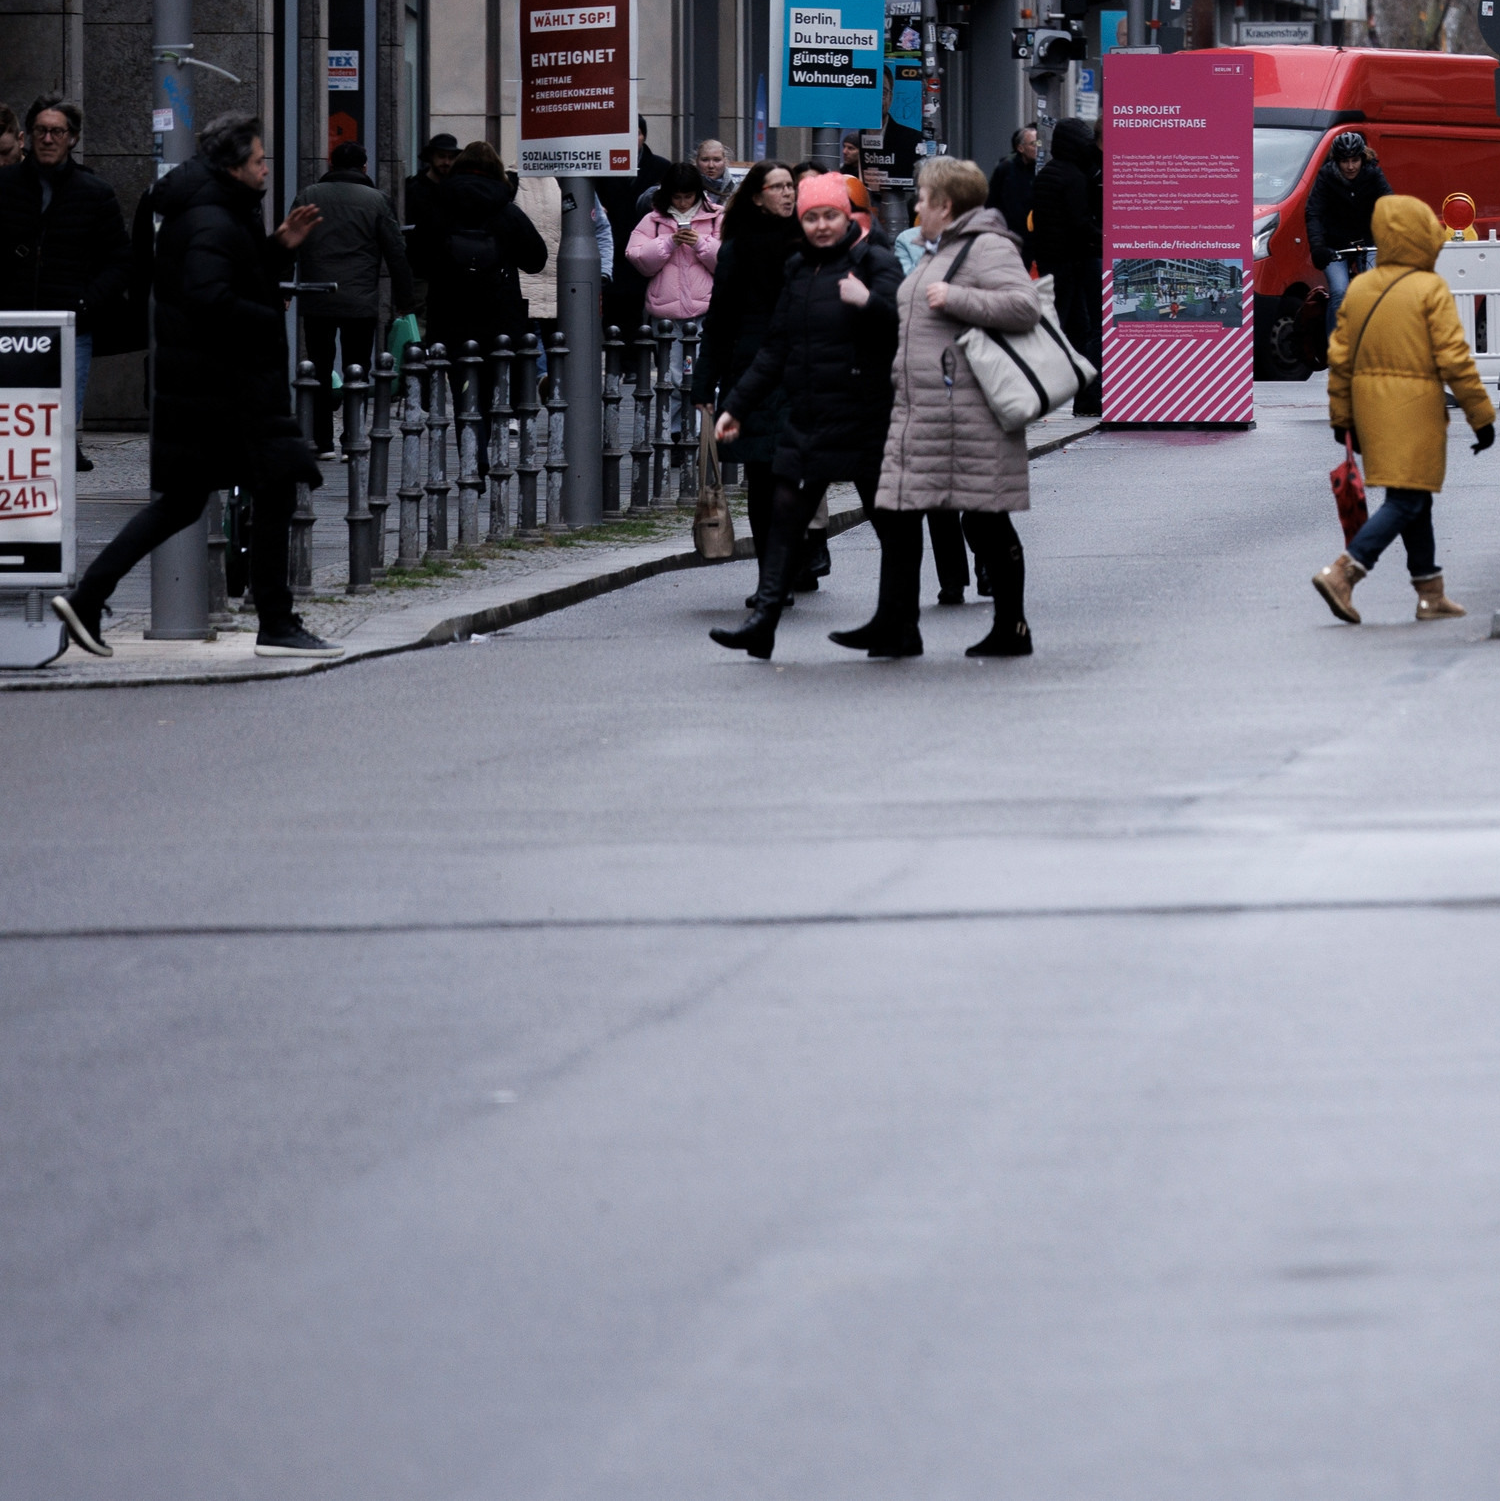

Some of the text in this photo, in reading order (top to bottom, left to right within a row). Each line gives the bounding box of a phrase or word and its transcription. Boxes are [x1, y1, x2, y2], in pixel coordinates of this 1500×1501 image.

[890, 1, 921, 14] STEFAN
[534, 12, 611, 28] WÄHLT SGP!
[795, 13, 836, 27] Berlin,
[794, 32, 873, 46] Du brauchst
[531, 48, 616, 67] ENTEIGNET
[794, 52, 849, 67] günstige
[536, 76, 572, 86] MIETHAIE
[793, 70, 873, 86] Wohnungen.
[536, 87, 615, 100] ENERGIEKONZERNE
[536, 101, 615, 114] KRIEGSGEWINNLER
[1113, 105, 1181, 115] DAS PROJEKT
[1113, 119, 1207, 128] FRIEDRICHSTRAßE
[863, 139, 881, 147] Lucas
[522, 150, 602, 163] SOZIALISTISCHE
[612, 156, 628, 165] SGP
[865, 152, 895, 164] Schaal
[523, 162, 602, 171] GLEICHHEITSPARTEI
[1112, 241, 1241, 250] www.berlin.de/friedrichstrasse
[0, 336, 51, 353] evue
[0, 487, 47, 511] 24h
